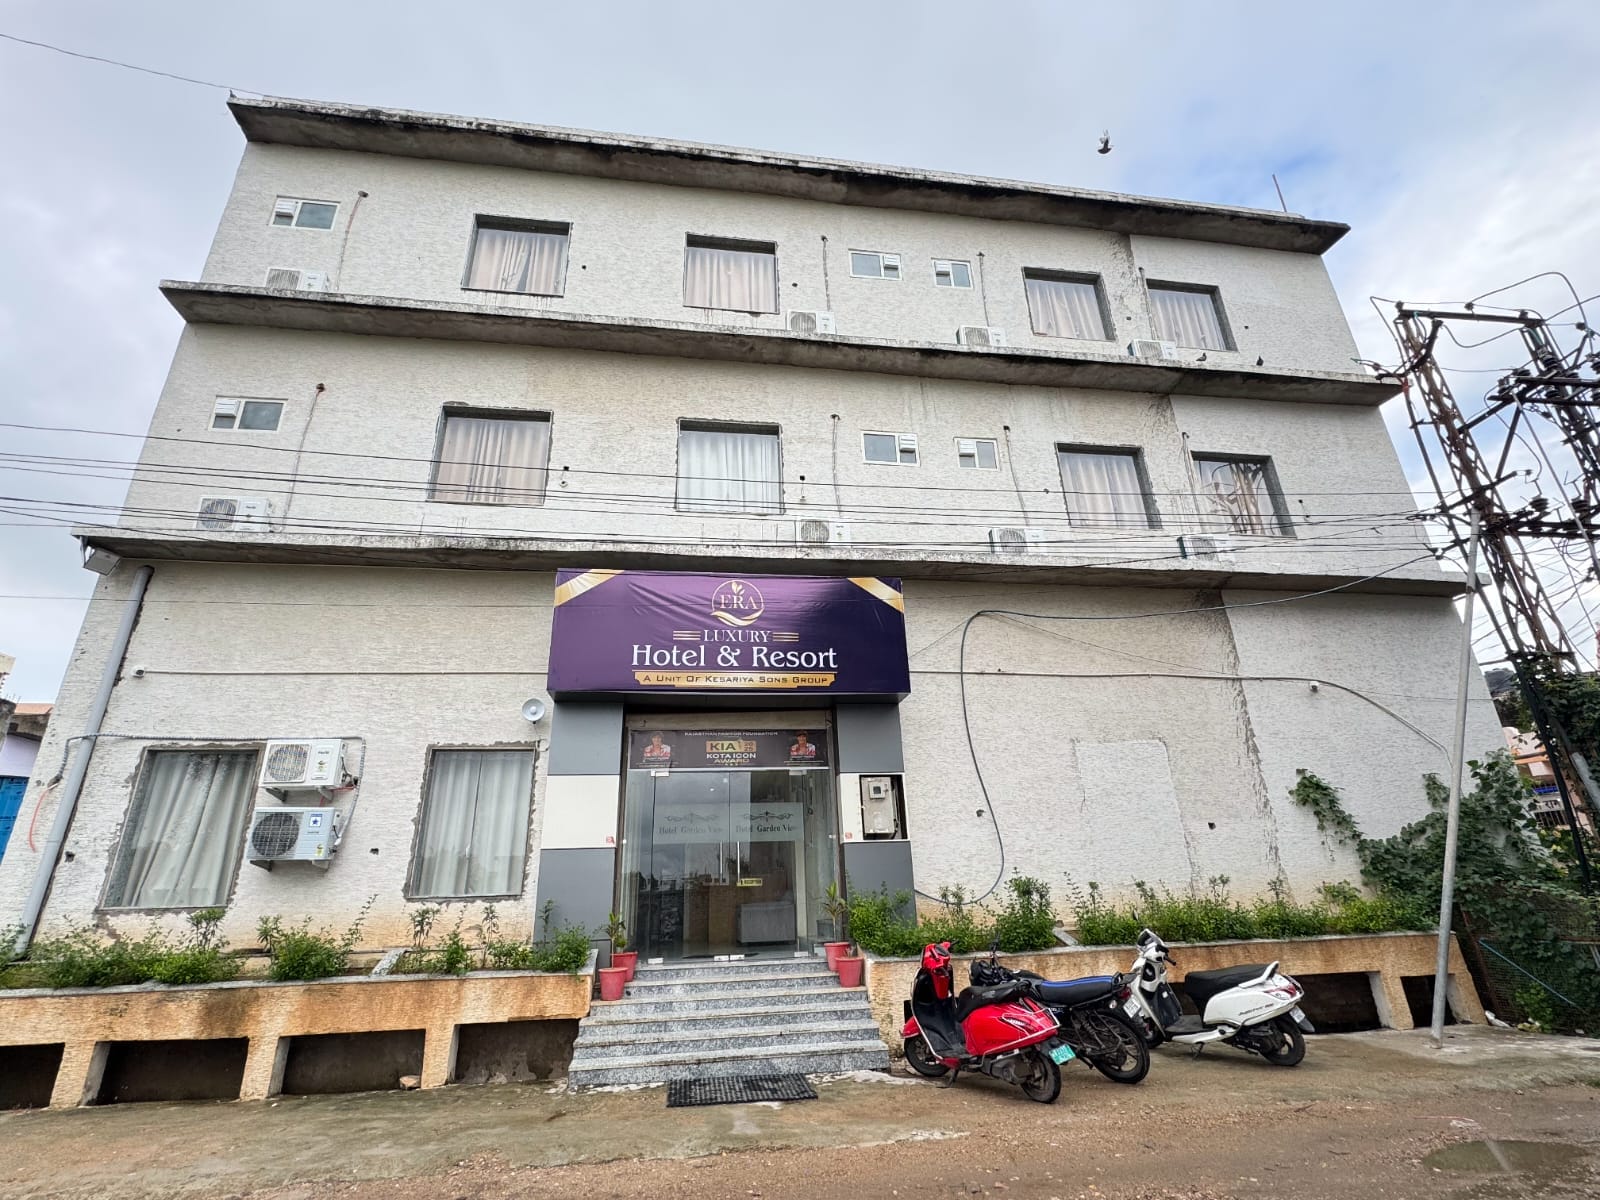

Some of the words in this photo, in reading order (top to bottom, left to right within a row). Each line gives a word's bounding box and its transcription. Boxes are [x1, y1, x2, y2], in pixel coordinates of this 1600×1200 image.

[720, 593, 759, 610] ERA
[704, 630, 772, 643] LUXURY
[632, 645, 705, 667] Hotel
[717, 646, 740, 667] &
[752, 646, 838, 668] Resort
[643, 675, 652, 683] A
[710, 742, 736, 751] KIA
[757, 824, 781, 832] Garden
